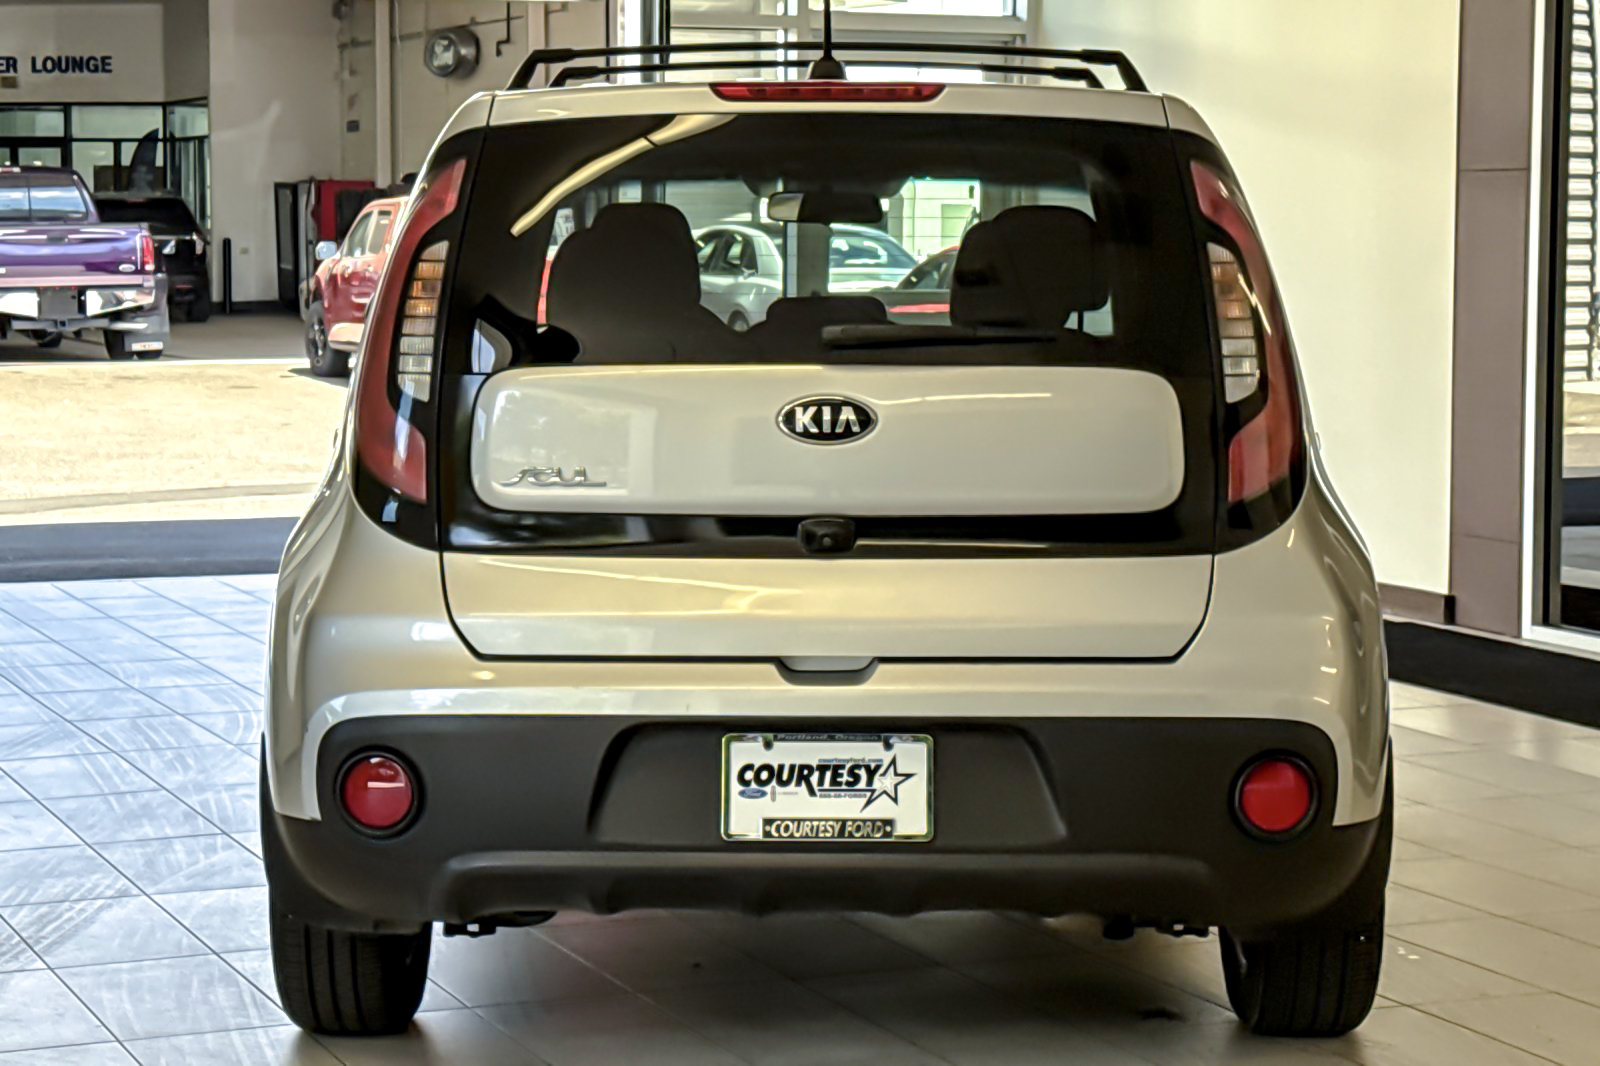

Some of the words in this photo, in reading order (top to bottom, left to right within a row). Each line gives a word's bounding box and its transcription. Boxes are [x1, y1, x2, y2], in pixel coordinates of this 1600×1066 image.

[31, 55, 113, 73] LOUNGE
[794, 405, 861, 433] KIA
[737, 763, 884, 797] COURTESY
[770, 820, 842, 837] COURTESY
[844, 820, 884, 837] FORD
